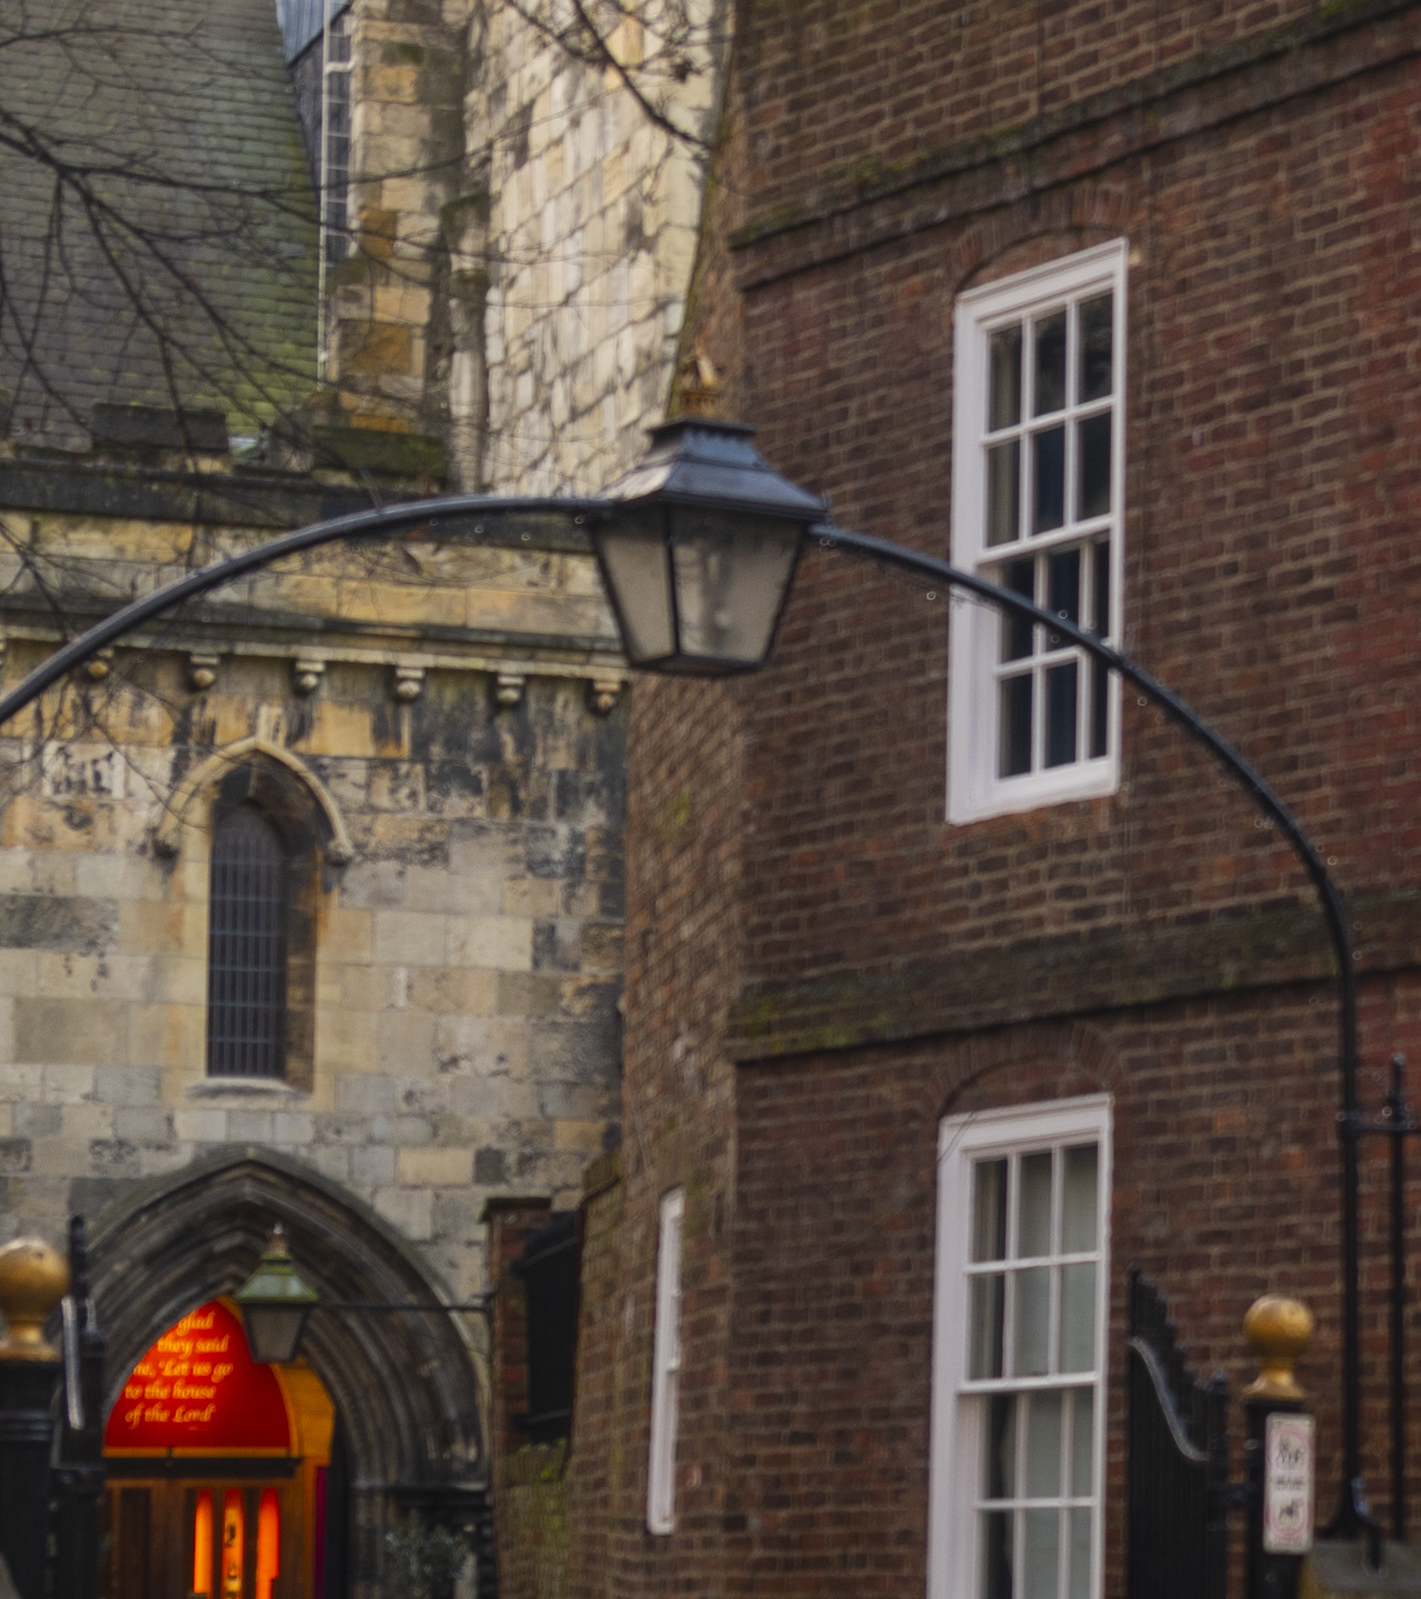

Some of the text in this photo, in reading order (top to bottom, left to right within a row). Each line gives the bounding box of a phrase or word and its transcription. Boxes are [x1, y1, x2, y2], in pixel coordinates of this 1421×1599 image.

[195, 1334, 230, 1353] said
[192, 1362, 212, 1377] us
[211, 1362, 234, 1383] go
[125, 1378, 217, 1400] to the house
[125, 1403, 217, 1430] of the Lord
